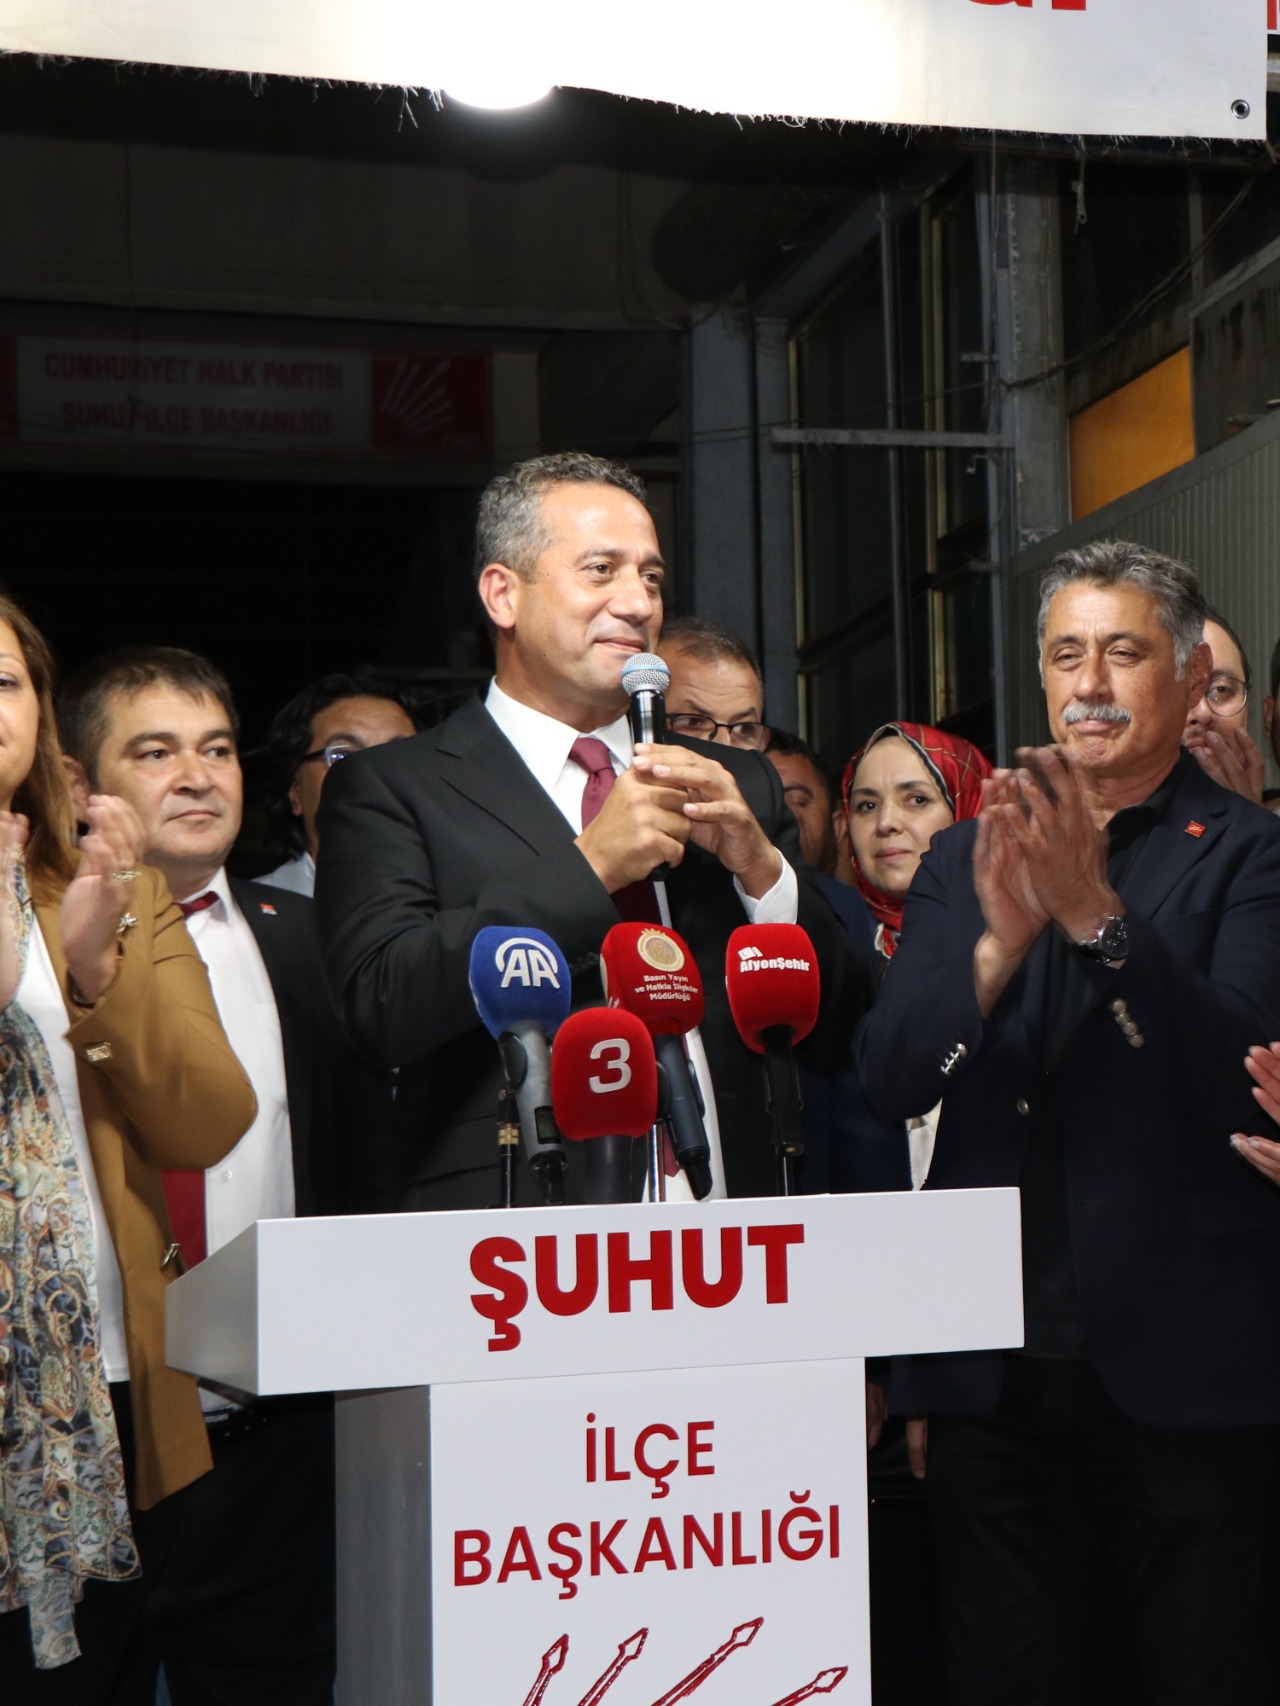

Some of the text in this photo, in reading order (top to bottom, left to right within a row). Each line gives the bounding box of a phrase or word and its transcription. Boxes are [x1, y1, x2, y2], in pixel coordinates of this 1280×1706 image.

[198, 359, 256, 388] HALK
[201, 402, 331, 437] BAŞKANLIĞI
[500, 948, 561, 990] AA
[643, 973, 689, 983] Basın Yayın
[740, 957, 810, 973] AfyonŞehir
[646, 983, 672, 991] Halkla
[649, 992, 691, 1002] Müdürlüğü
[588, 1037, 632, 1094] 3
[469, 1223, 805, 1352] ŞUHUT
[585, 1412, 716, 1499] İLÇE
[453, 1489, 841, 1601] BAŞKANLIĞI
